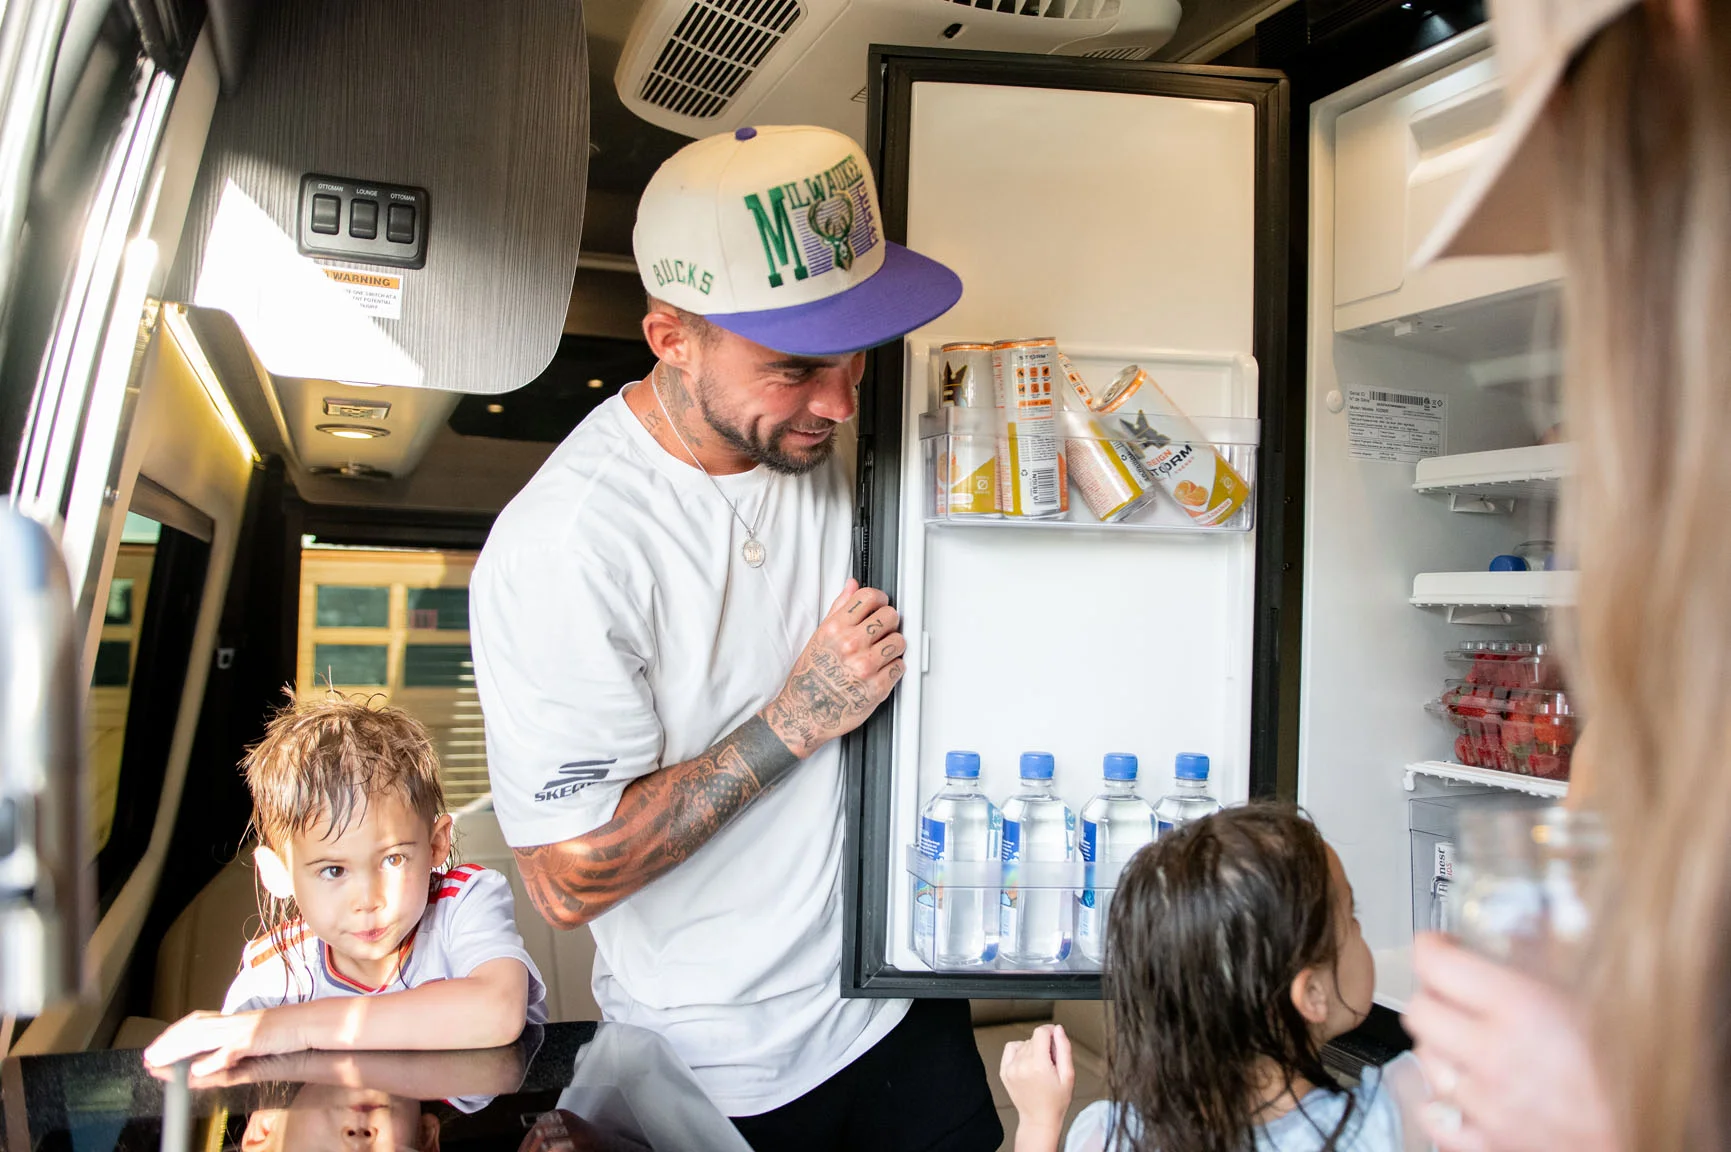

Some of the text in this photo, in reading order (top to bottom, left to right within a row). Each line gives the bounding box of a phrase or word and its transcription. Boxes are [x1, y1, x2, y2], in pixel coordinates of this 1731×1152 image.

[318, 183, 344, 193] OTTOMAN
[356, 188, 378, 197] LOUNGE
[390, 193, 416, 202] OTTOMAN
[333, 271, 391, 287] WARNING
[653, 258, 714, 295] BUCKS
[1146, 449, 1173, 467] REIGN
[1437, 847, 1449, 892] Hnest
